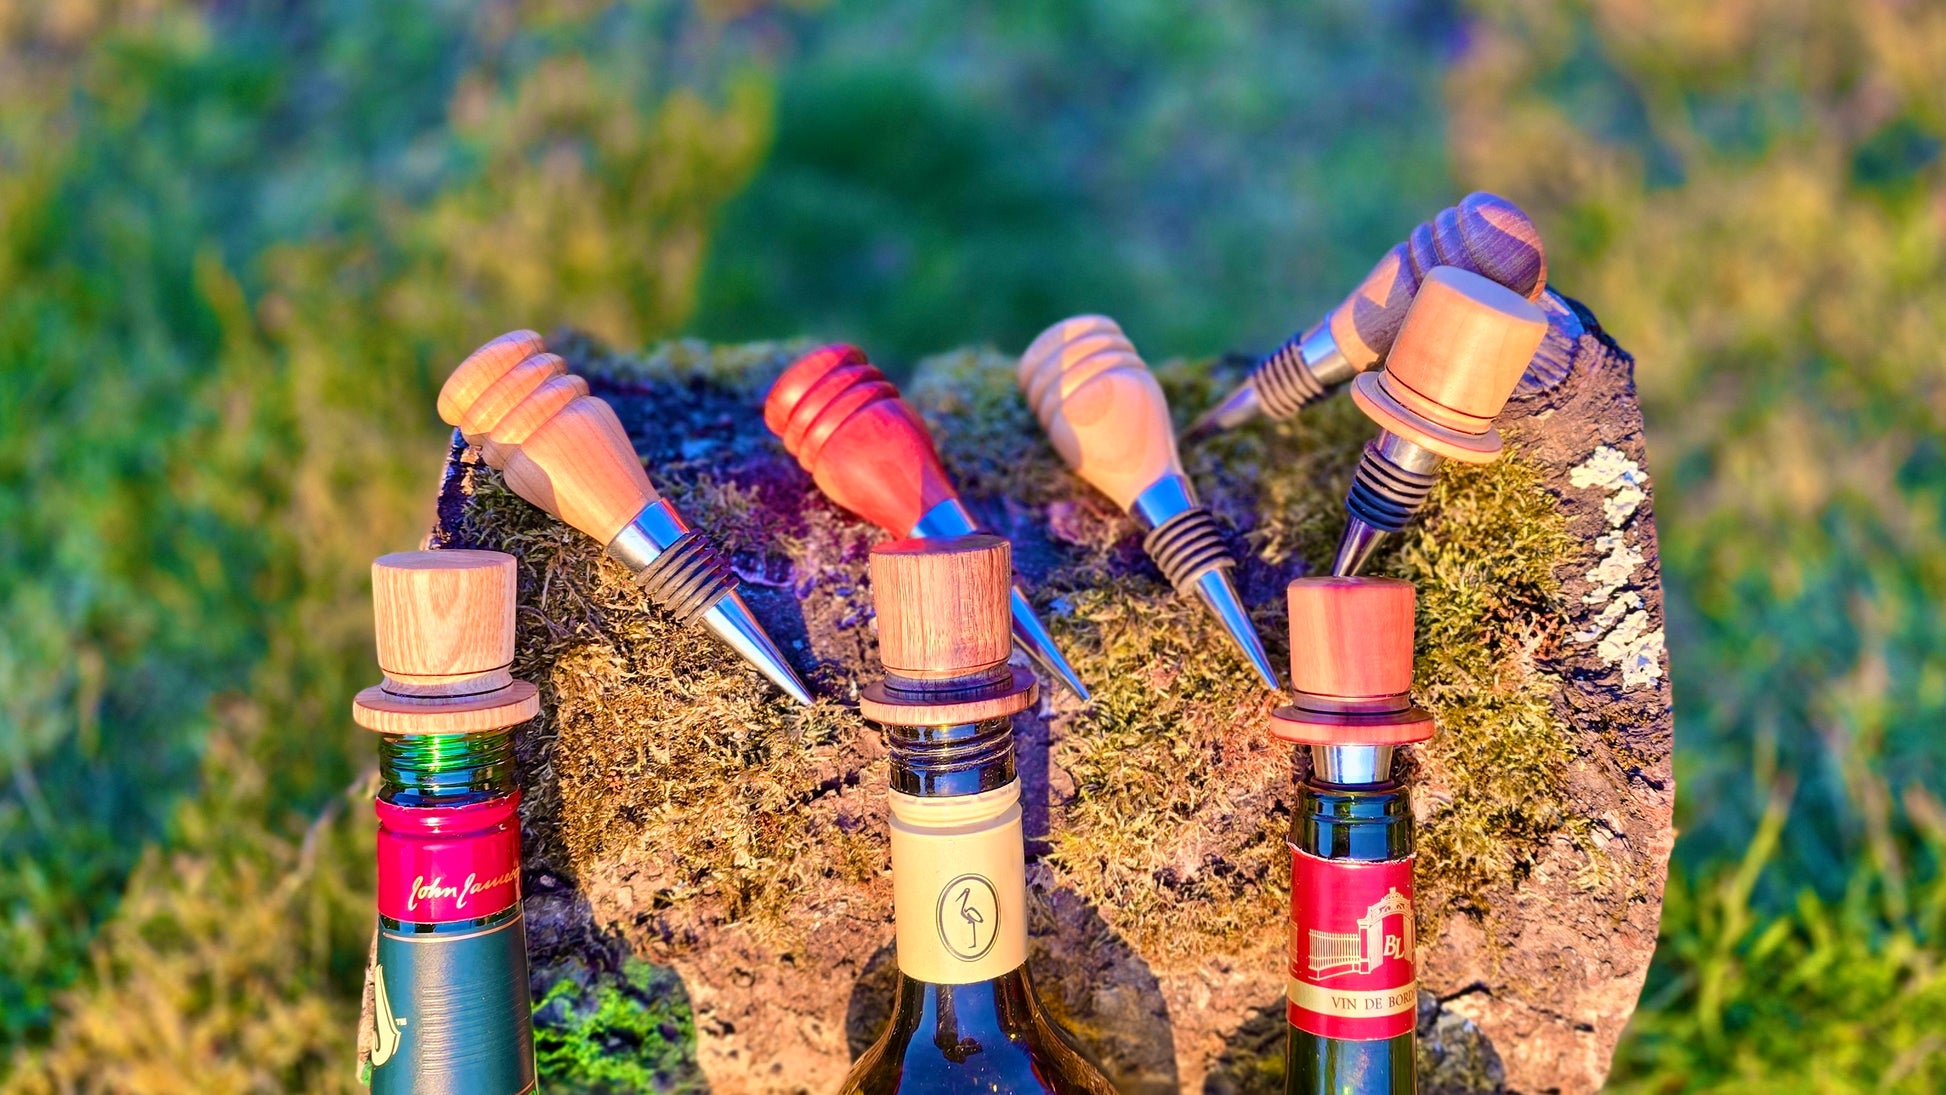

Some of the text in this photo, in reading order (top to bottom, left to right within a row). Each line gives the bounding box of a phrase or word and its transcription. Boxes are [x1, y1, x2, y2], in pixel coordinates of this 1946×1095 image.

[408, 876, 457, 911] John
[1384, 934, 1404, 959] BL
[1331, 996, 1357, 1010] VIN
[1365, 997, 1383, 1009] DE
